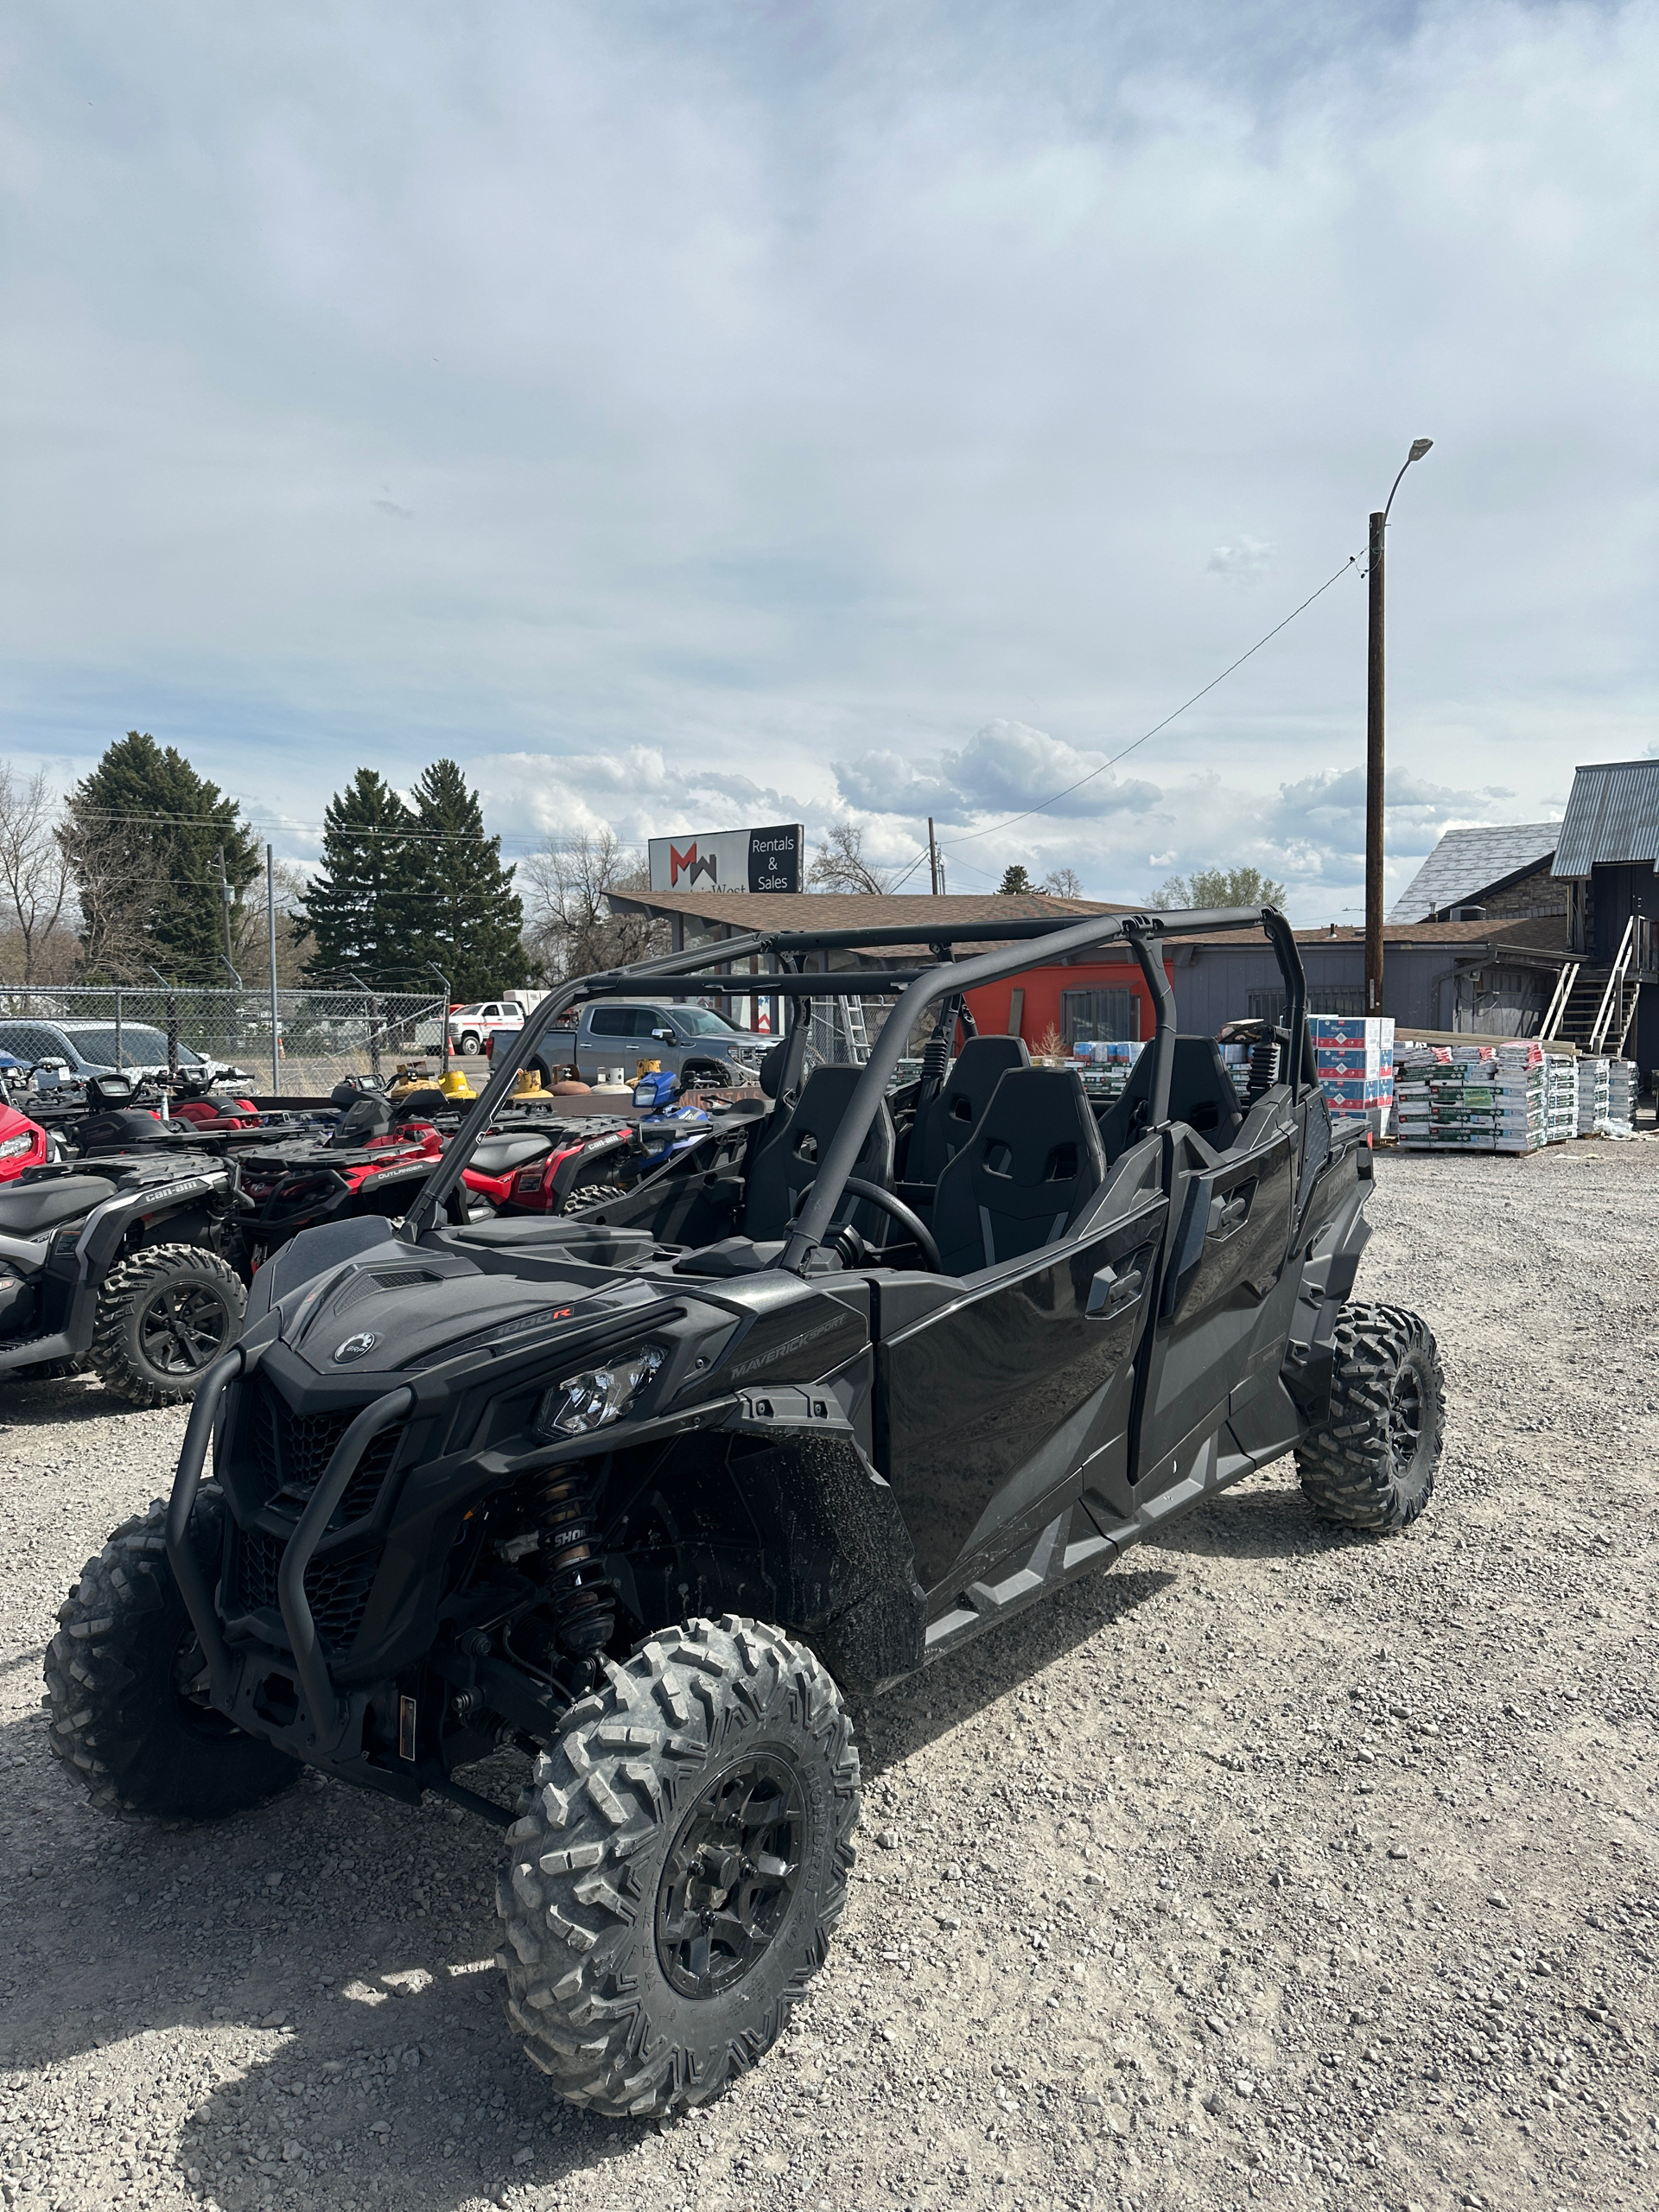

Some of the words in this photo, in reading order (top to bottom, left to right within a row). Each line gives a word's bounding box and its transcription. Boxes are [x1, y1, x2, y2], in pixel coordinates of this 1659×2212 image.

[753, 836, 794, 853] Rentals
[768, 857, 778, 870] &
[758, 875, 788, 890] Sales
[588, 1135, 619, 1150] can-am
[378, 1164, 423, 1179] OUTLANDER
[145, 1180, 198, 1202] can-am
[496, 1308, 571, 1338] 1000R
[731, 1334, 809, 1380] MAVERICK
[808, 1315, 846, 1340] SPORT
[802, 1761, 826, 1893] BIGHORN
